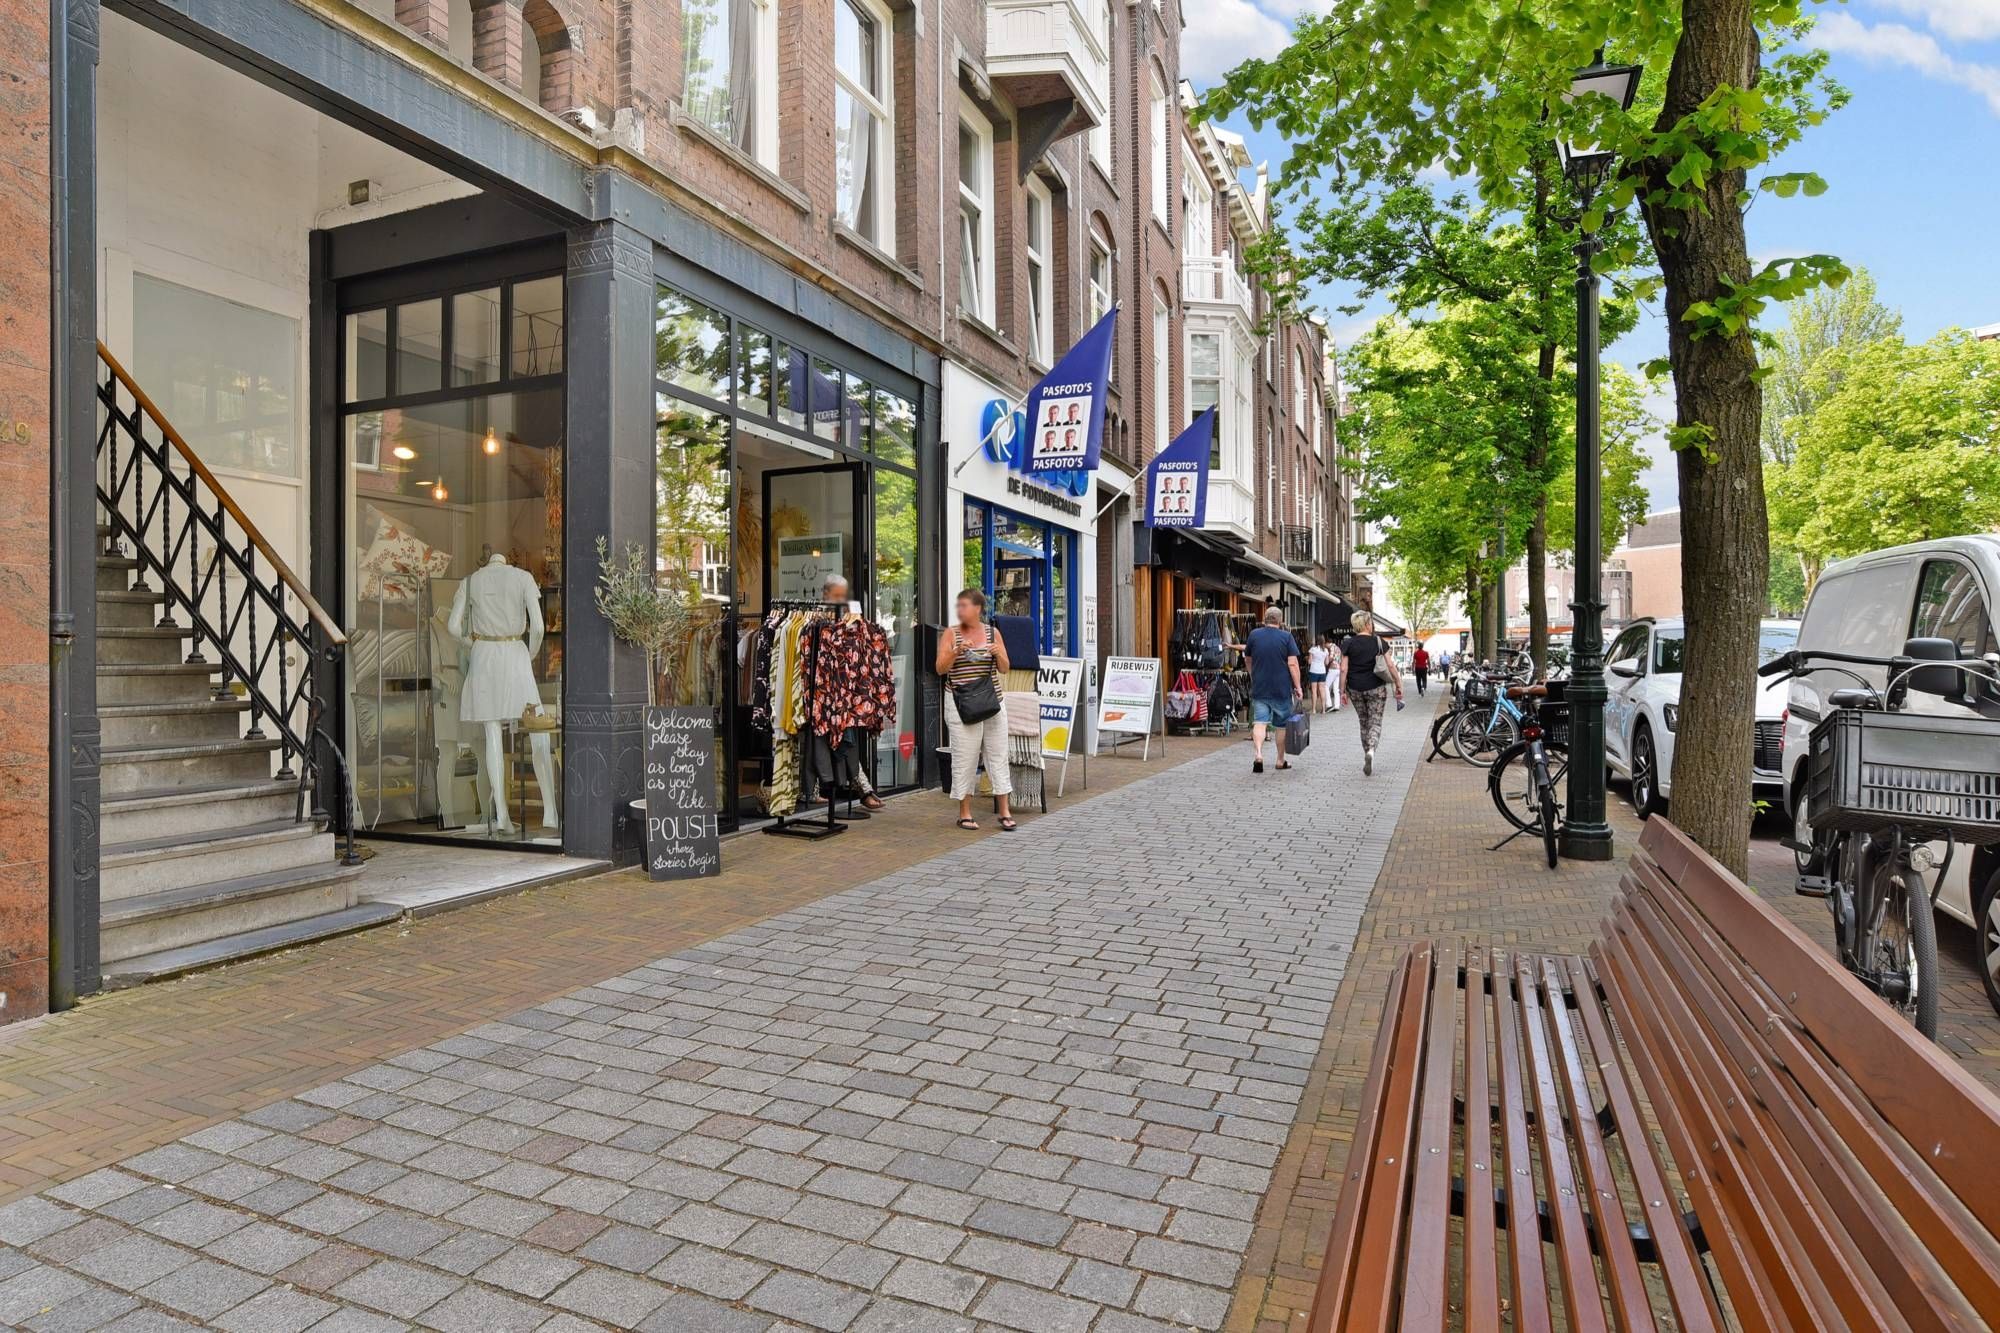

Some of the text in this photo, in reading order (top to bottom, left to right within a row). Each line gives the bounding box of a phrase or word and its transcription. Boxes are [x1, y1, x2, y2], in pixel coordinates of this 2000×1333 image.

[1043, 382, 1092, 396] PASFOTO'S
[1033, 456, 1083, 470] PASFOTO'S
[1158, 461, 1198, 471] PASFOTO'S
[1007, 477, 1082, 518] DE FOTOSPECIALIST
[1154, 516, 1193, 526] PASFOTO'S
[1111, 661, 1154, 672] RIJBEWIJS
[1038, 668, 1071, 685] NKT
[647, 709, 713, 729] Welcome
[1040, 707, 1068, 719] RATIS
[648, 730, 692, 750] please
[674, 746, 709, 766] stay
[648, 756, 696, 783] as long
[647, 777, 691, 799] as you
[667, 841, 694, 854] where
[653, 852, 716, 873] stories begin
